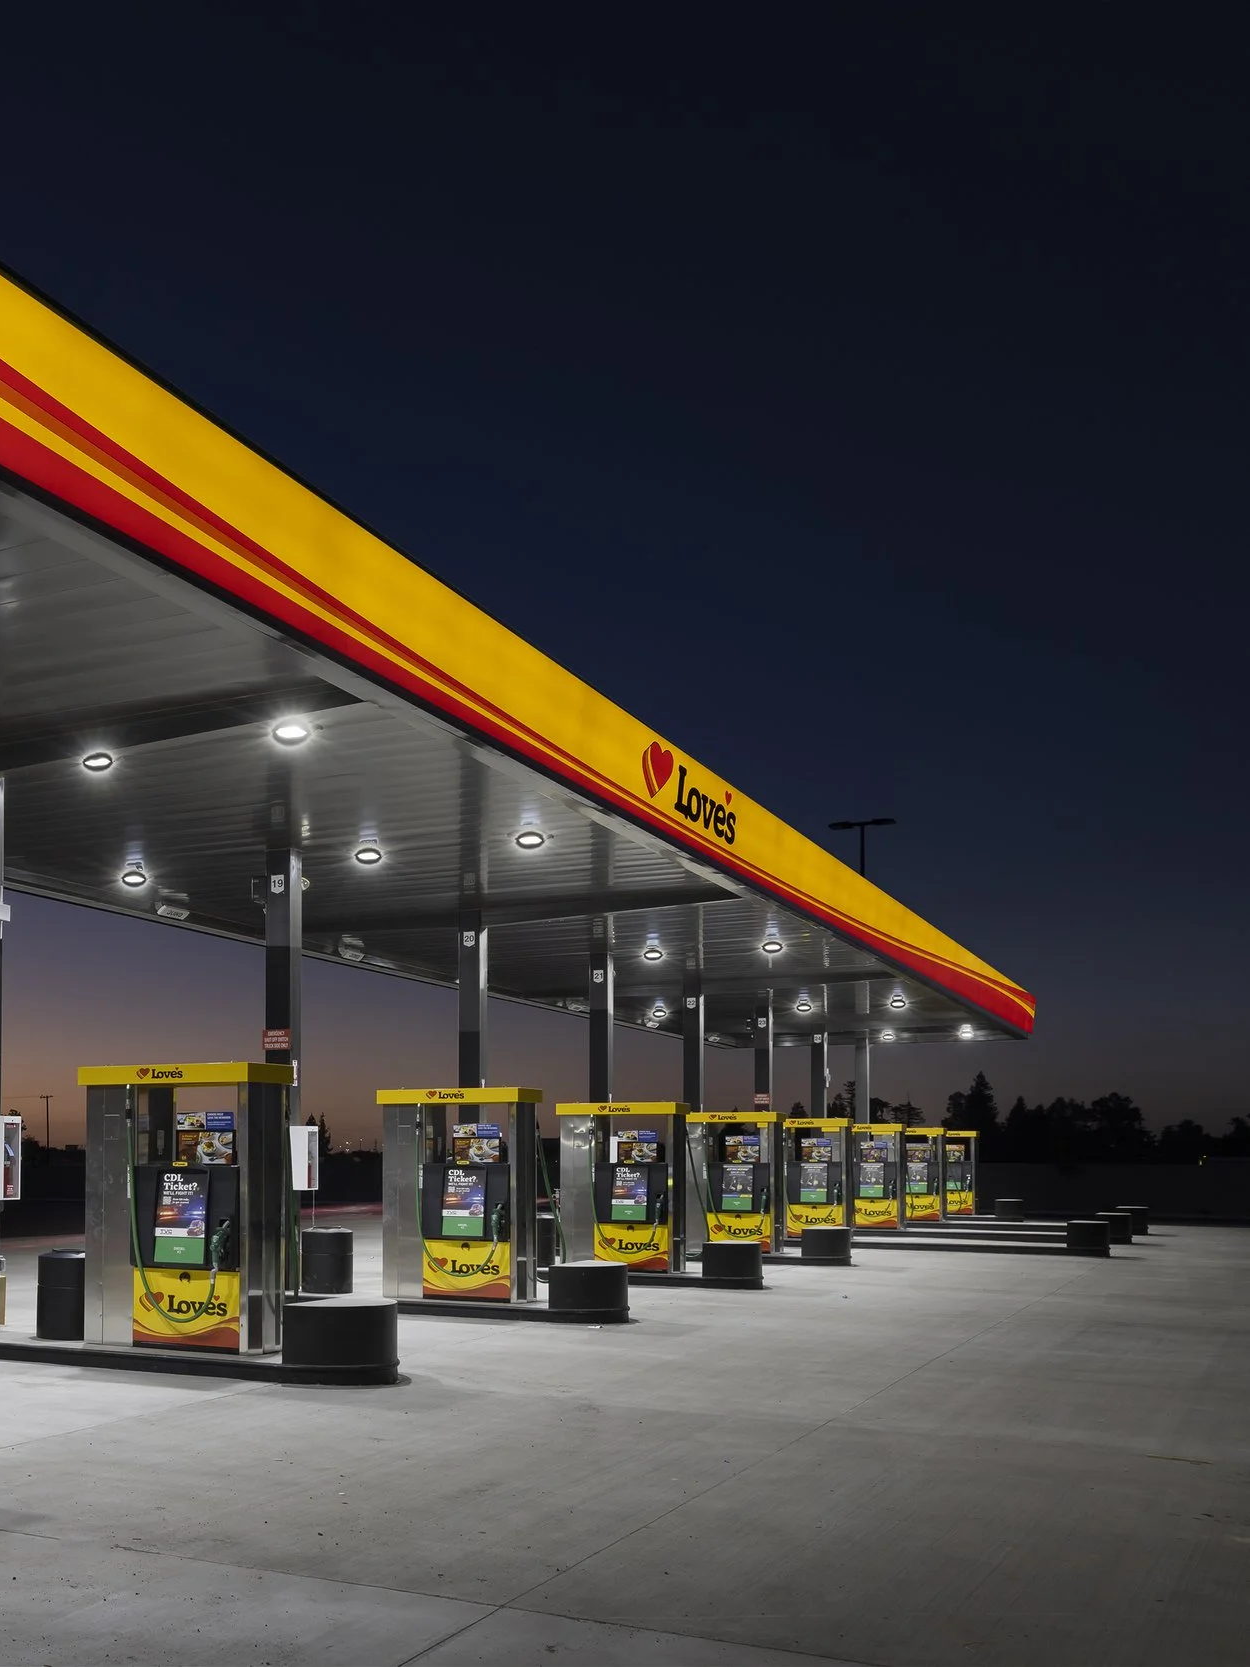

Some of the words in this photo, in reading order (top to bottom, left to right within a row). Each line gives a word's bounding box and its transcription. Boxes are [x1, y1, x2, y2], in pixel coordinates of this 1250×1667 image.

[272, 878, 284, 889] 19
[464, 935, 475, 943] 20
[595, 972, 603, 980] 21
[164, 1174, 183, 1182] CDL
[448, 1175, 477, 1183] Ticket?
[163, 1182, 198, 1191] Ticket?
